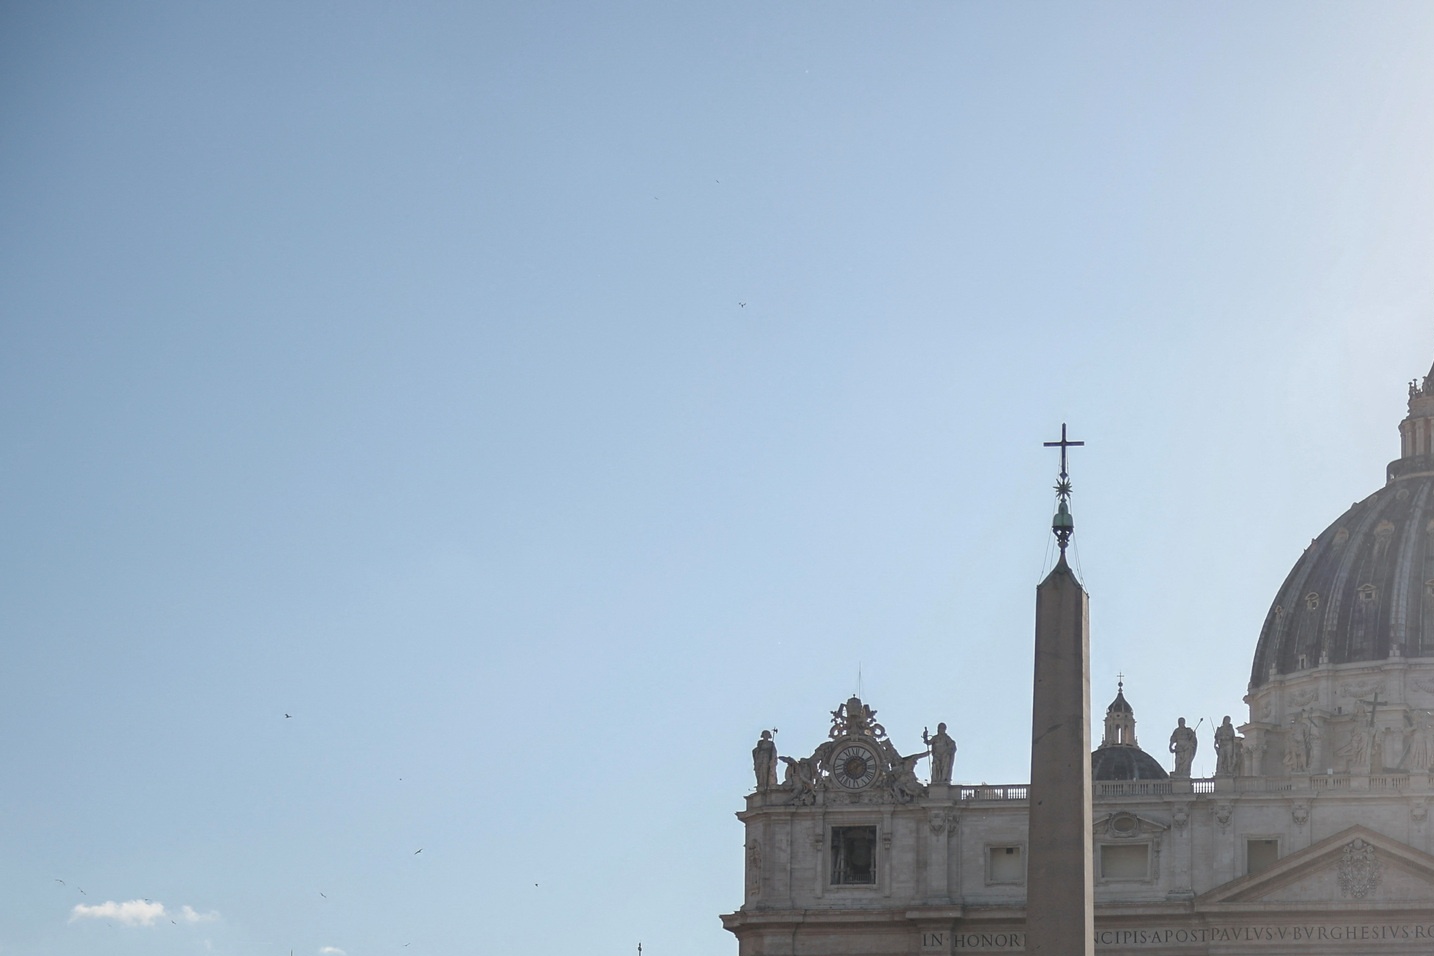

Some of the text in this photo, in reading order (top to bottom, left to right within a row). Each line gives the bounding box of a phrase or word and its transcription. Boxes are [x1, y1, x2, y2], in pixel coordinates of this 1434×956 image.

[922, 933, 943, 947] IN
[1152, 928, 1209, 944] APOST
[1211, 926, 1273, 941] PAVLVS
[1293, 925, 1409, 941] BVRGHESIVS
